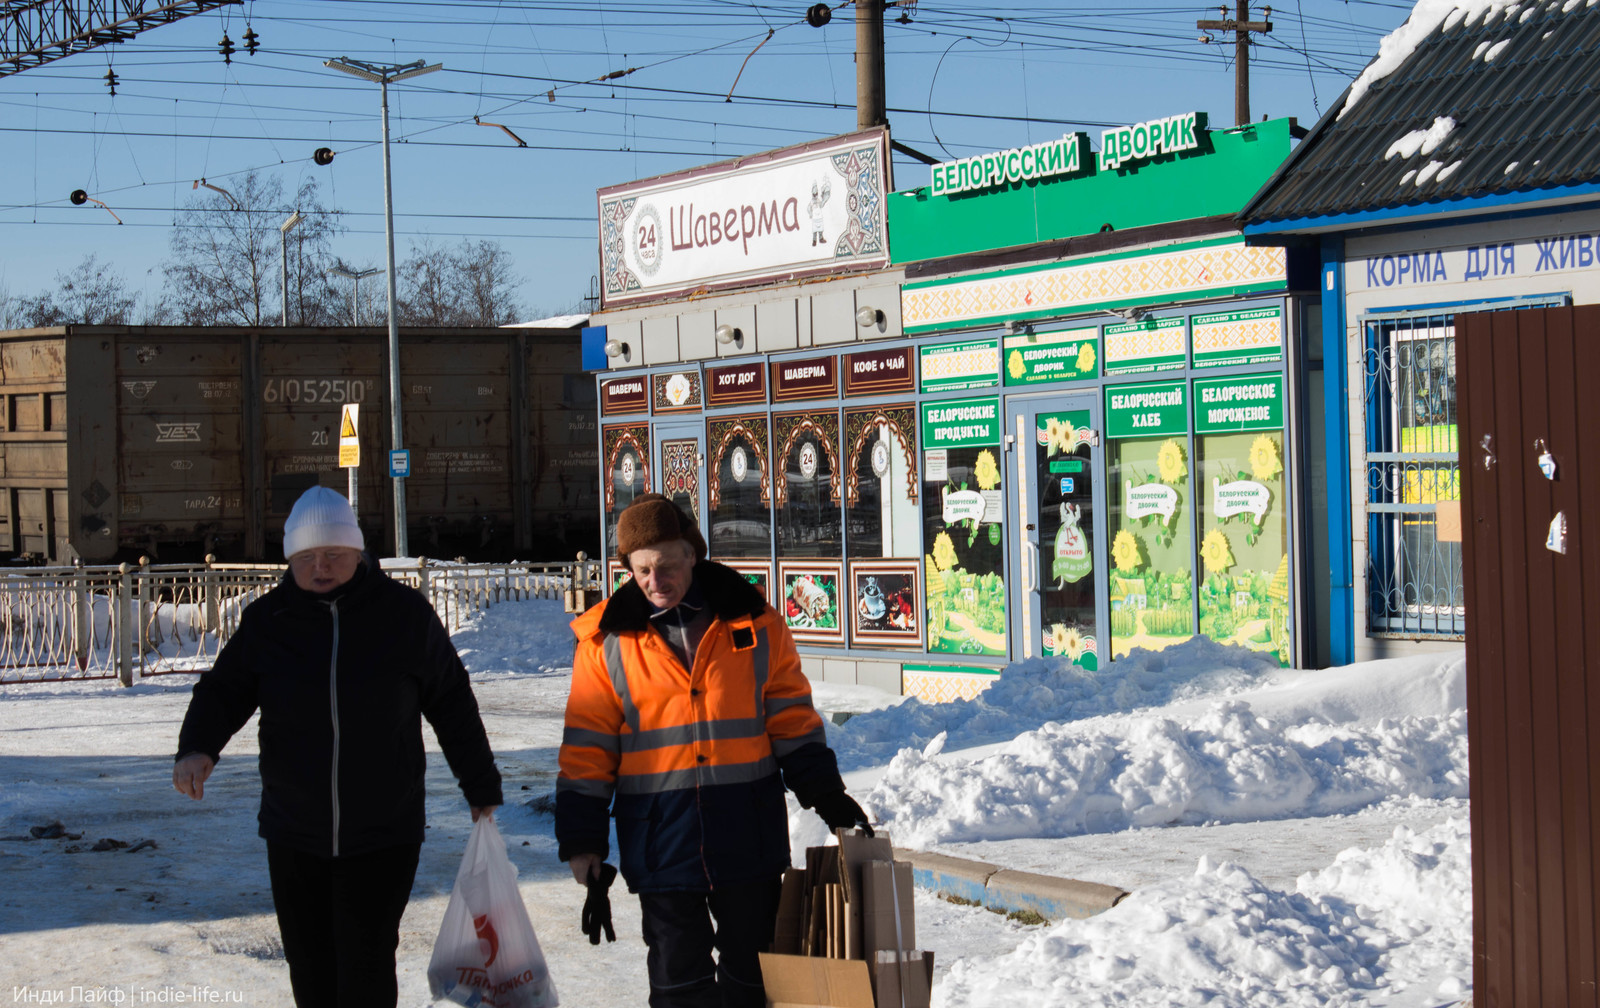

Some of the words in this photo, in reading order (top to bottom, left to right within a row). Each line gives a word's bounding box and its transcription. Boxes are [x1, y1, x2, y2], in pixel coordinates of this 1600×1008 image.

[931, 132, 1080, 197] БЕЛОРУССКИЙ
[1099, 112, 1198, 171] ДВОРИК
[669, 197, 800, 257] Шаверма
[638, 224, 656, 249] 24
[640, 249, 656, 260] часа
[1366, 250, 1448, 288] КОРМА
[1464, 242, 1514, 280] ДЛЯ
[1535, 233, 1600, 272] ЖИВ
[1197, 316, 1229, 324] СДЕЛАНО
[1109, 325, 1138, 333] СДЕЛАНО
[1023, 342, 1078, 361] БЕЛОРУССКИЙ
[853, 359, 878, 374] КОФЕ
[886, 354, 905, 370] ЧАЙ
[1033, 361, 1065, 374] ДВОРИК
[1194, 357, 1248, 368] БЕЛОРУССКИЙ
[1249, 355, 1281, 364] ДВОРИК
[718, 373, 737, 386] ХОТ
[737, 371, 757, 386] ДОГ
[784, 365, 827, 381] ШАВЕРМА
[264, 379, 365, 403] 61052510
[608, 382, 643, 396] ШАВЕРМА
[927, 383, 967, 392] БЕЛОРУССКИЙ
[968, 381, 993, 390] ДВОРИК
[1201, 383, 1277, 404] БЕЛОРУССКОЕ
[1111, 387, 1183, 410] БЕЛОРУССКИЙ
[927, 404, 996, 424] БЕЛОРУССКИЕ
[1132, 413, 1162, 428] ХЛЕБ
[1208, 405, 1271, 424] МОРОЖЕНОЕ
[312, 431, 329, 446] 20
[934, 424, 990, 442] ПРОДУКТЫ
[803, 453, 813, 465] 24
[624, 462, 633, 473] 24
[1130, 490, 1168, 500] БЕЛОРУССКИЙ
[1218, 488, 1260, 498] БЕЛОРУССКИЙ
[184, 498, 207, 509] ТАРА
[946, 497, 978, 505] БЕЛОРУССКИЙ
[1138, 502, 1159, 510] ДВОРИК
[1226, 500, 1249, 508] ДВОРИК
[456, 966, 534, 998] Пятрочка
